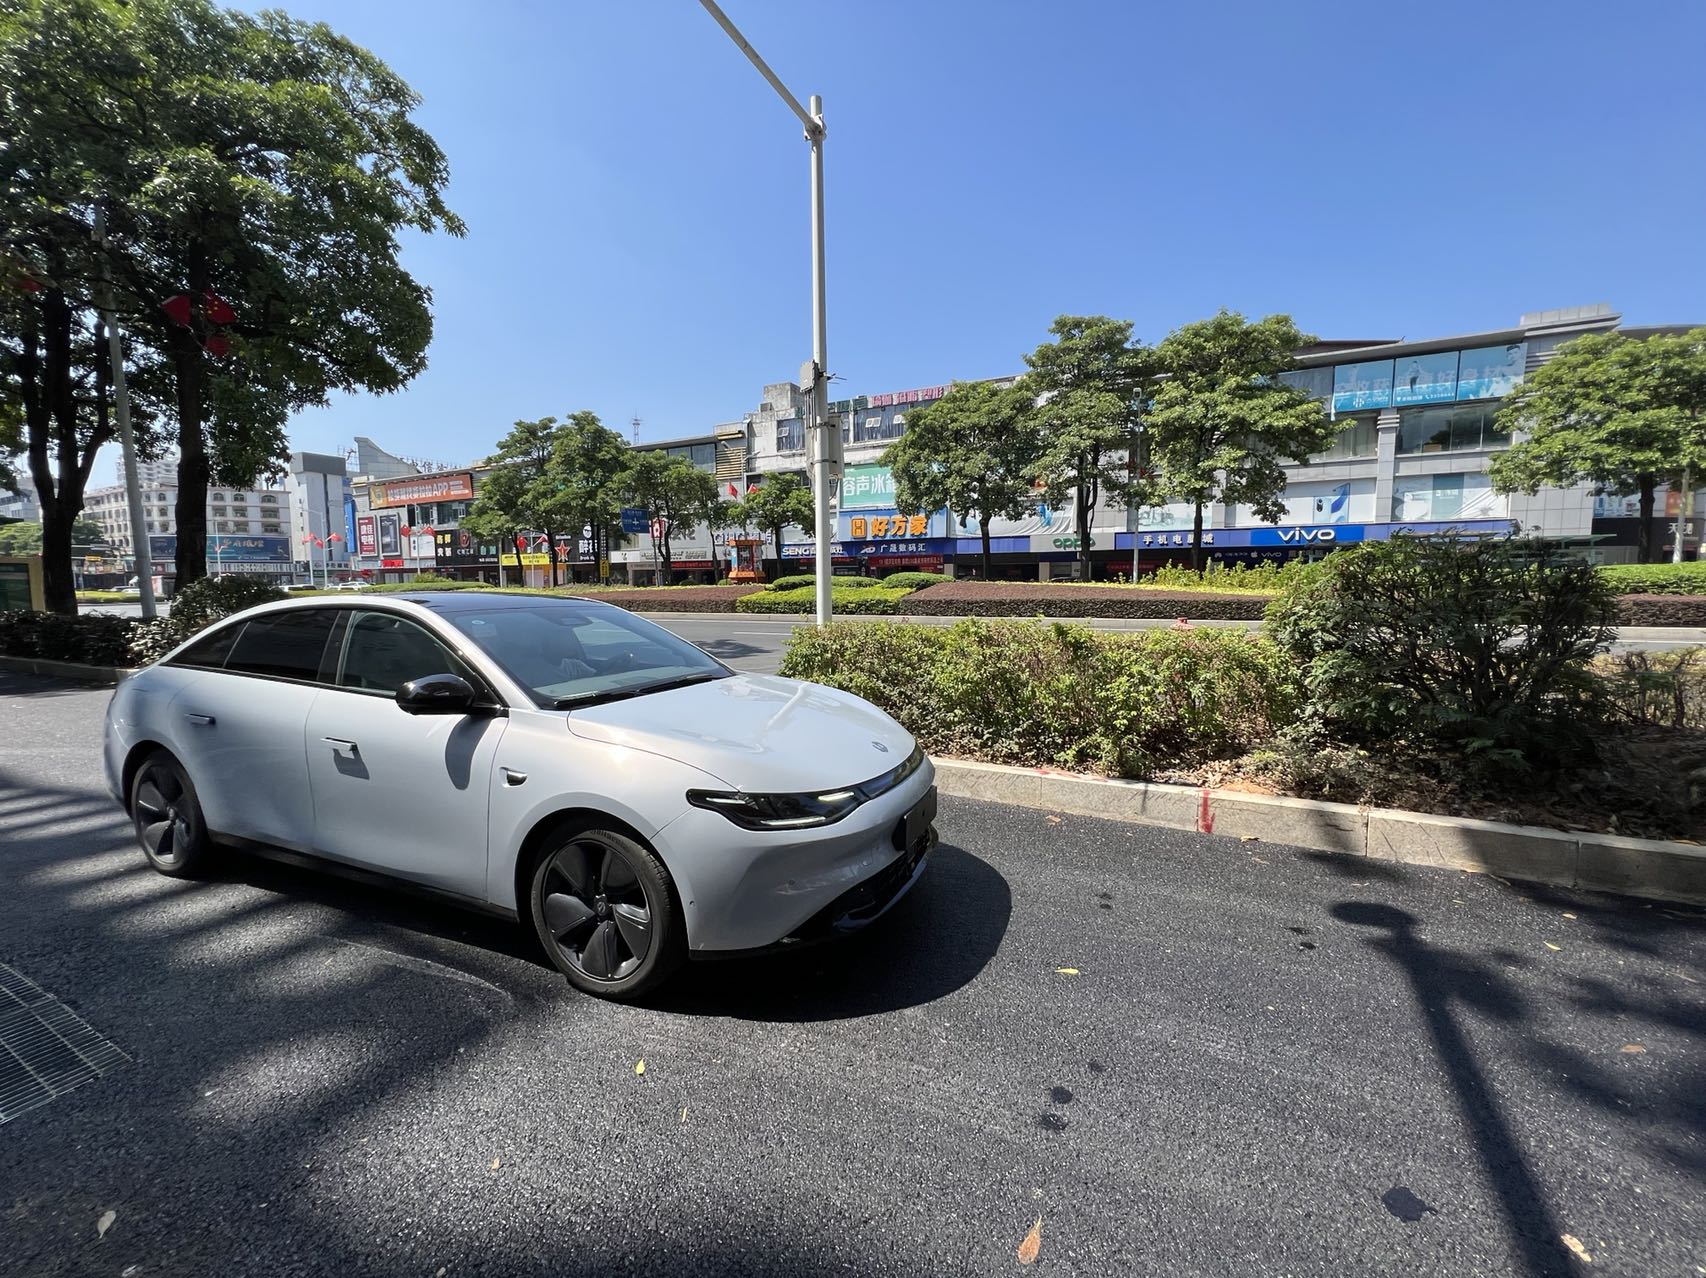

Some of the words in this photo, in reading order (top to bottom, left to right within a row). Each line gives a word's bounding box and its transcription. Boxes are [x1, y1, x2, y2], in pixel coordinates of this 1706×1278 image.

[871, 514, 928, 537] 好万家
[1277, 527, 1336, 541] vivo
